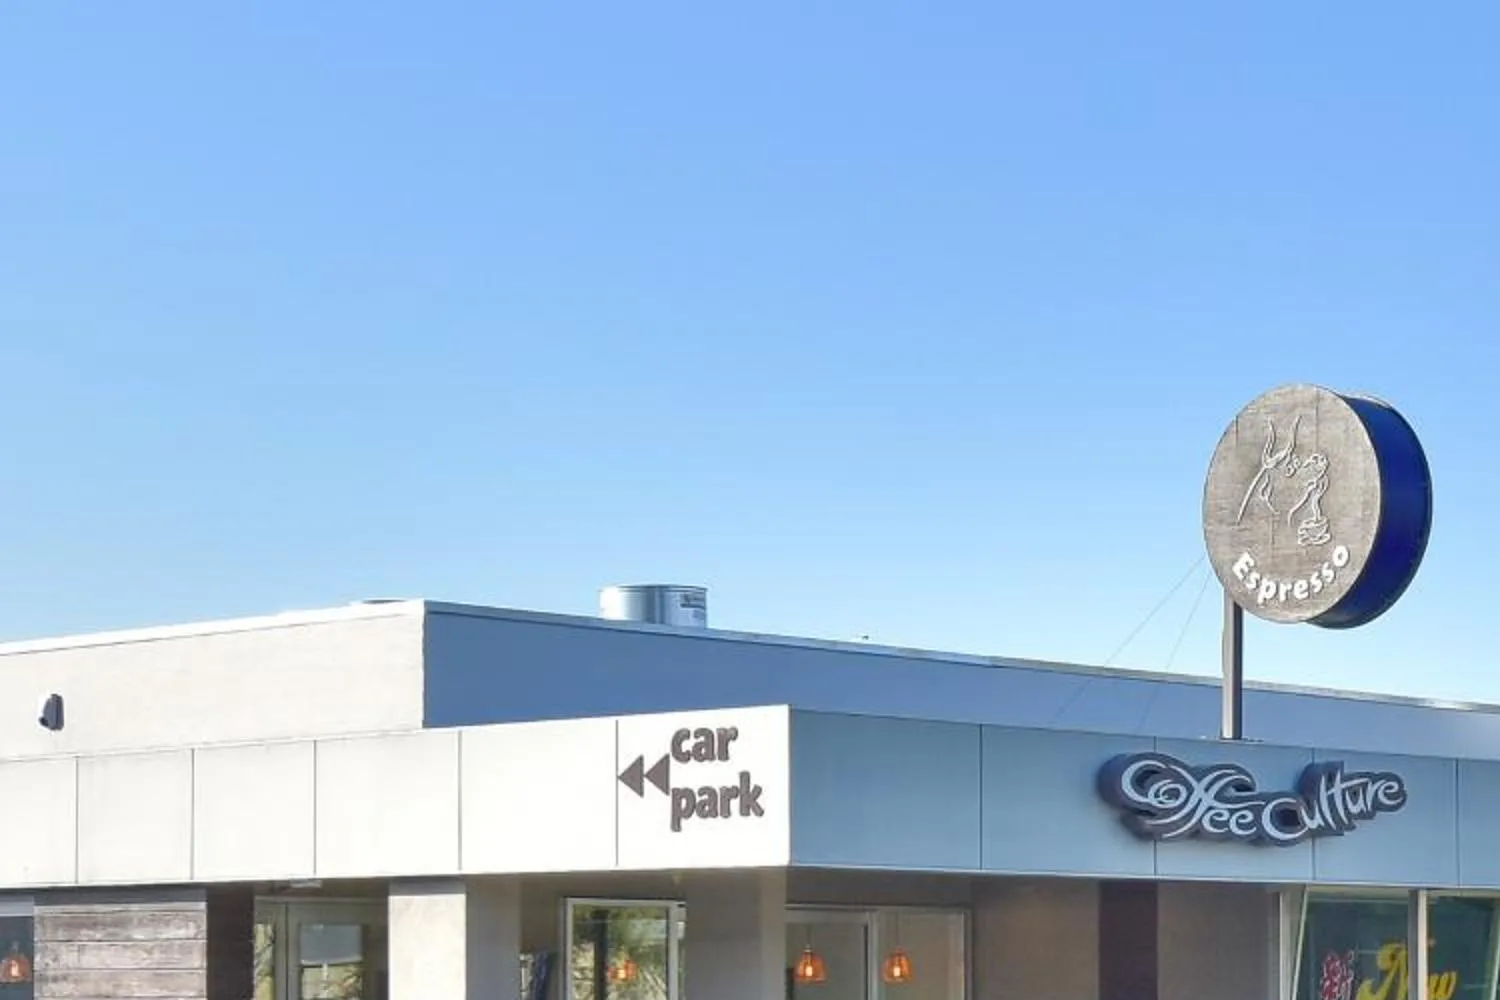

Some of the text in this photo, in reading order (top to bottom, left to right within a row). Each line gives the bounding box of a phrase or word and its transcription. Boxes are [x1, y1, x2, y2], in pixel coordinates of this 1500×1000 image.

[1232, 546, 1349, 605] Espresso
[671, 726, 739, 764] car
[670, 770, 765, 833] park
[1121, 759, 1404, 841] Coffee Culture
